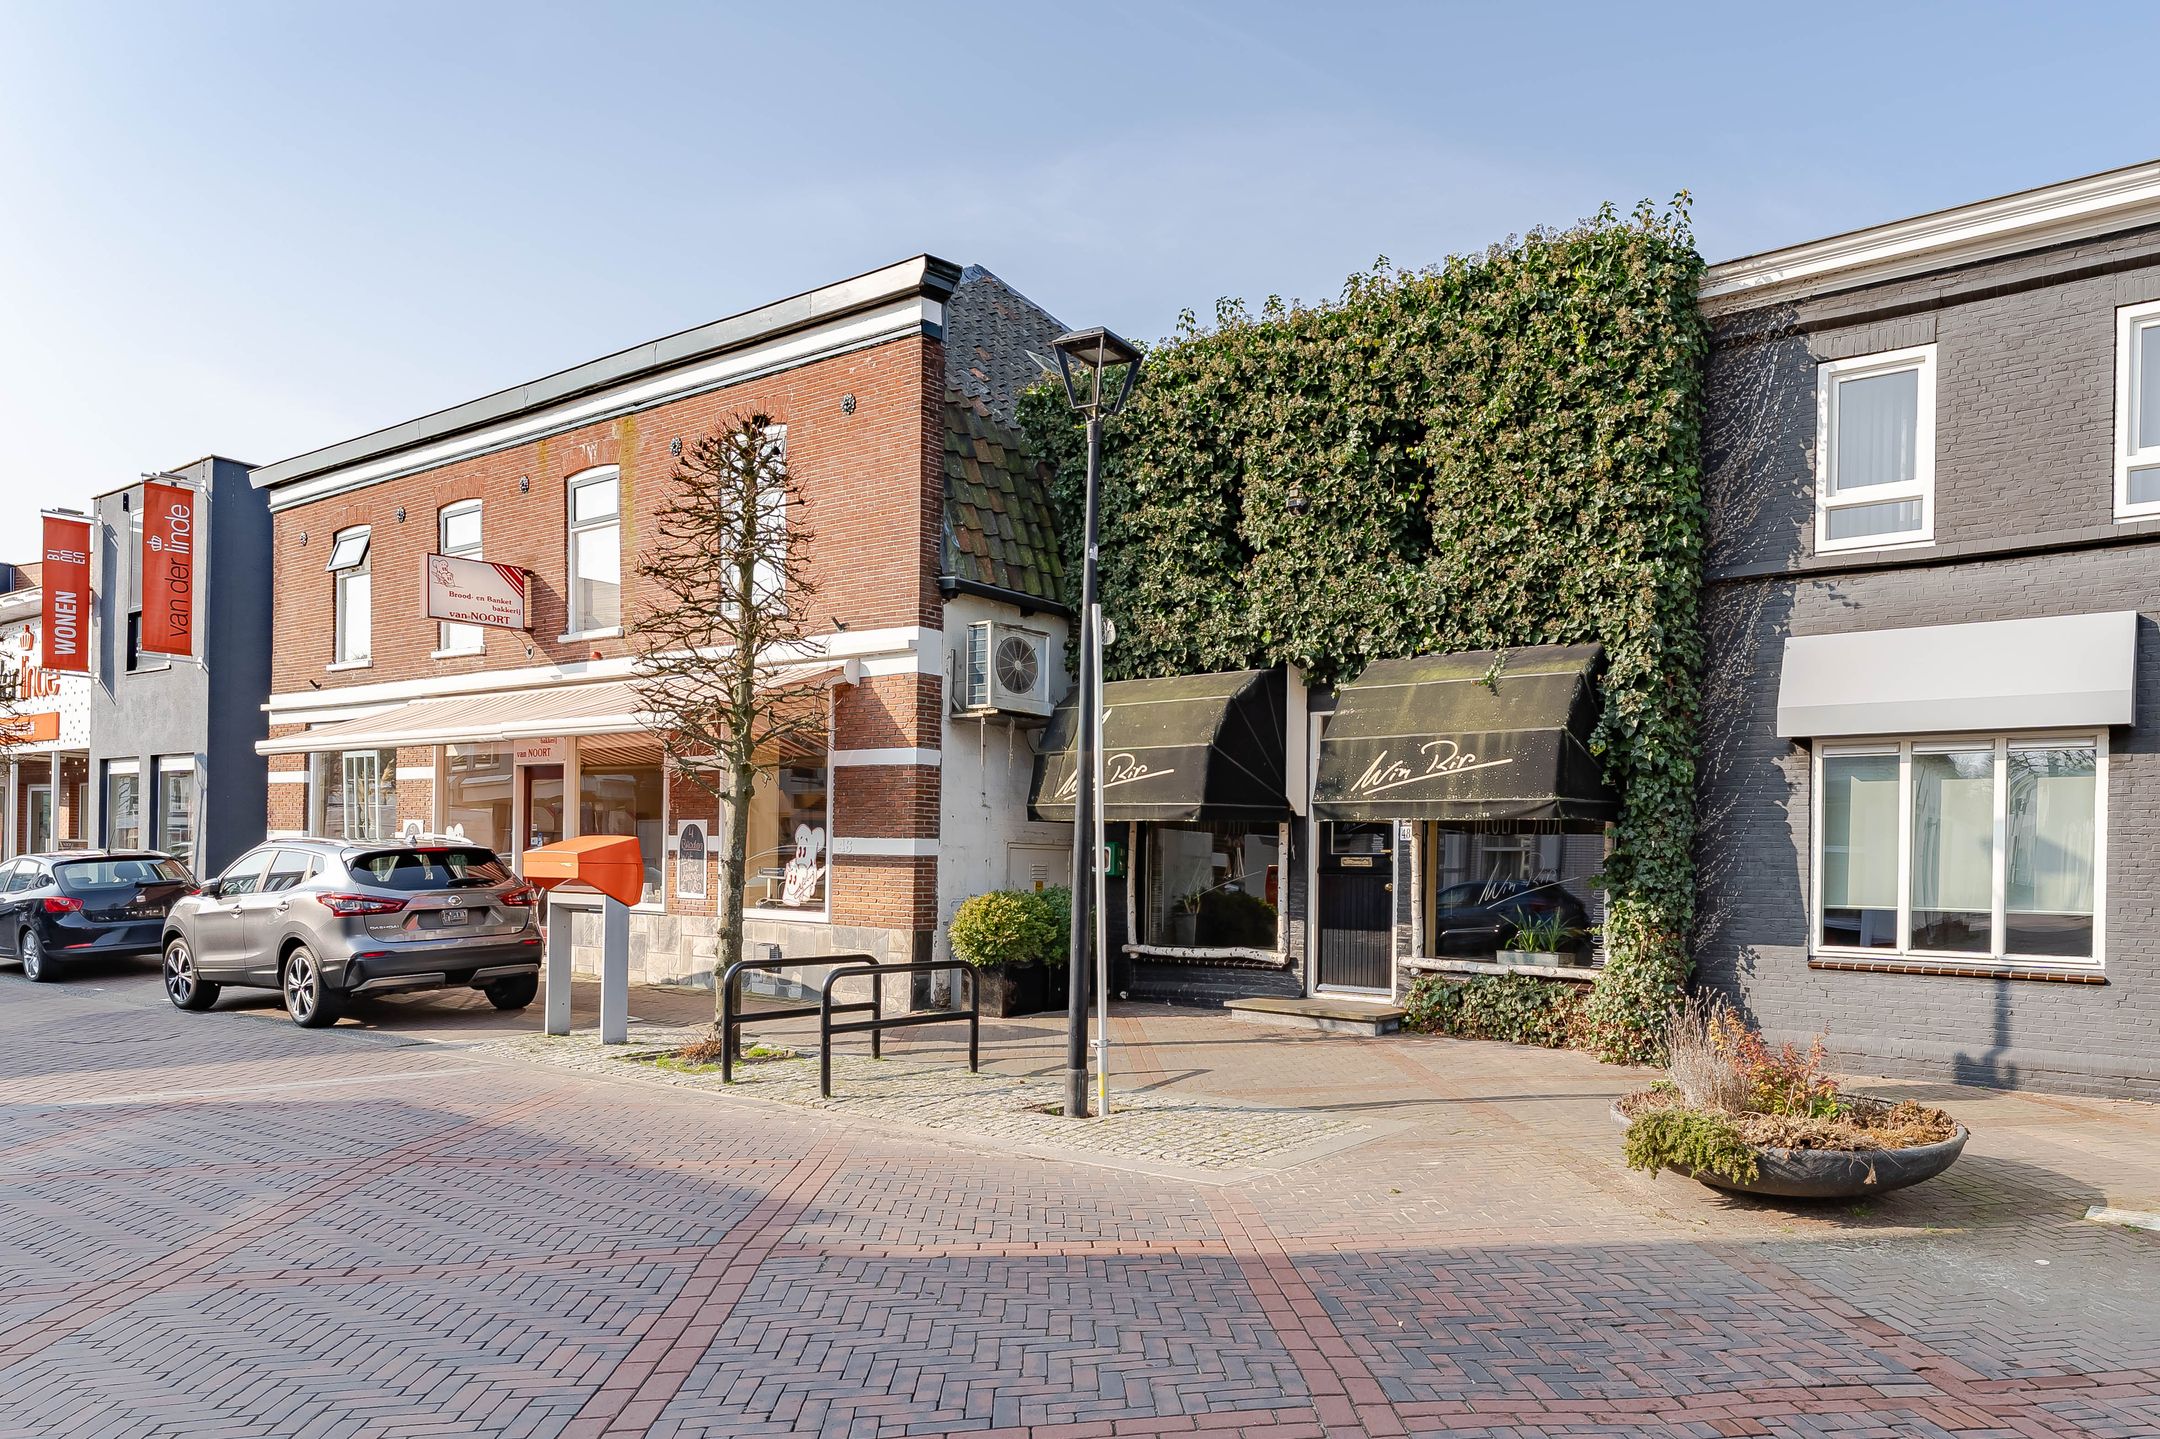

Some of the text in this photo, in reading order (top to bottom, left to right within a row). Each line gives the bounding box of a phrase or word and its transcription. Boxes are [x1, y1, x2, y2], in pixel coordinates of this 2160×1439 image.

[164, 504, 190, 636] van der linde
[487, 596, 512, 605] Banket
[492, 605, 521, 615] bakkerij
[54, 591, 77, 655] WONEN
[449, 611, 511, 625] van NOORT
[528, 748, 551, 757] NOORT
[1401, 828, 1411, 839] 48
